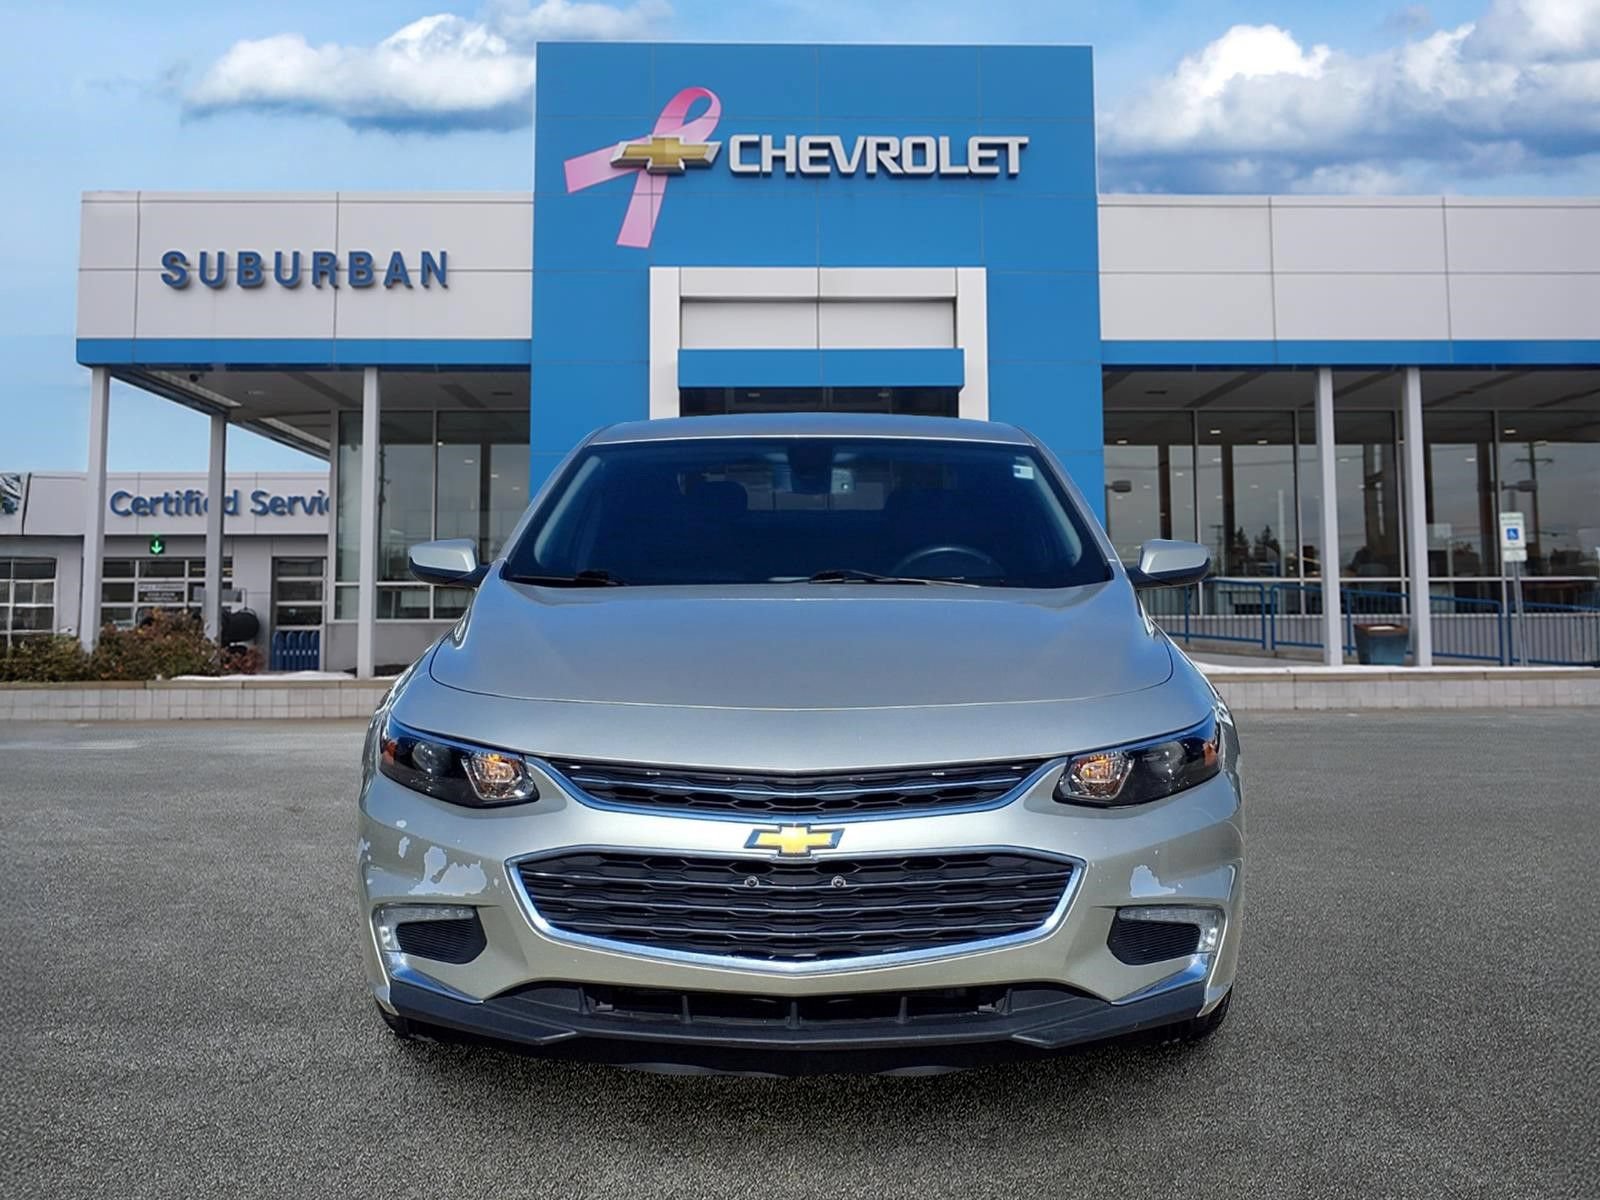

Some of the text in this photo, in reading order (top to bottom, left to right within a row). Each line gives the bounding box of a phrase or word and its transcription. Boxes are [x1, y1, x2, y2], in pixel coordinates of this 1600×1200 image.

[729, 134, 1029, 175] CHEVROLET
[161, 250, 449, 290] SUBURBAN
[109, 489, 240, 517] Certifid
